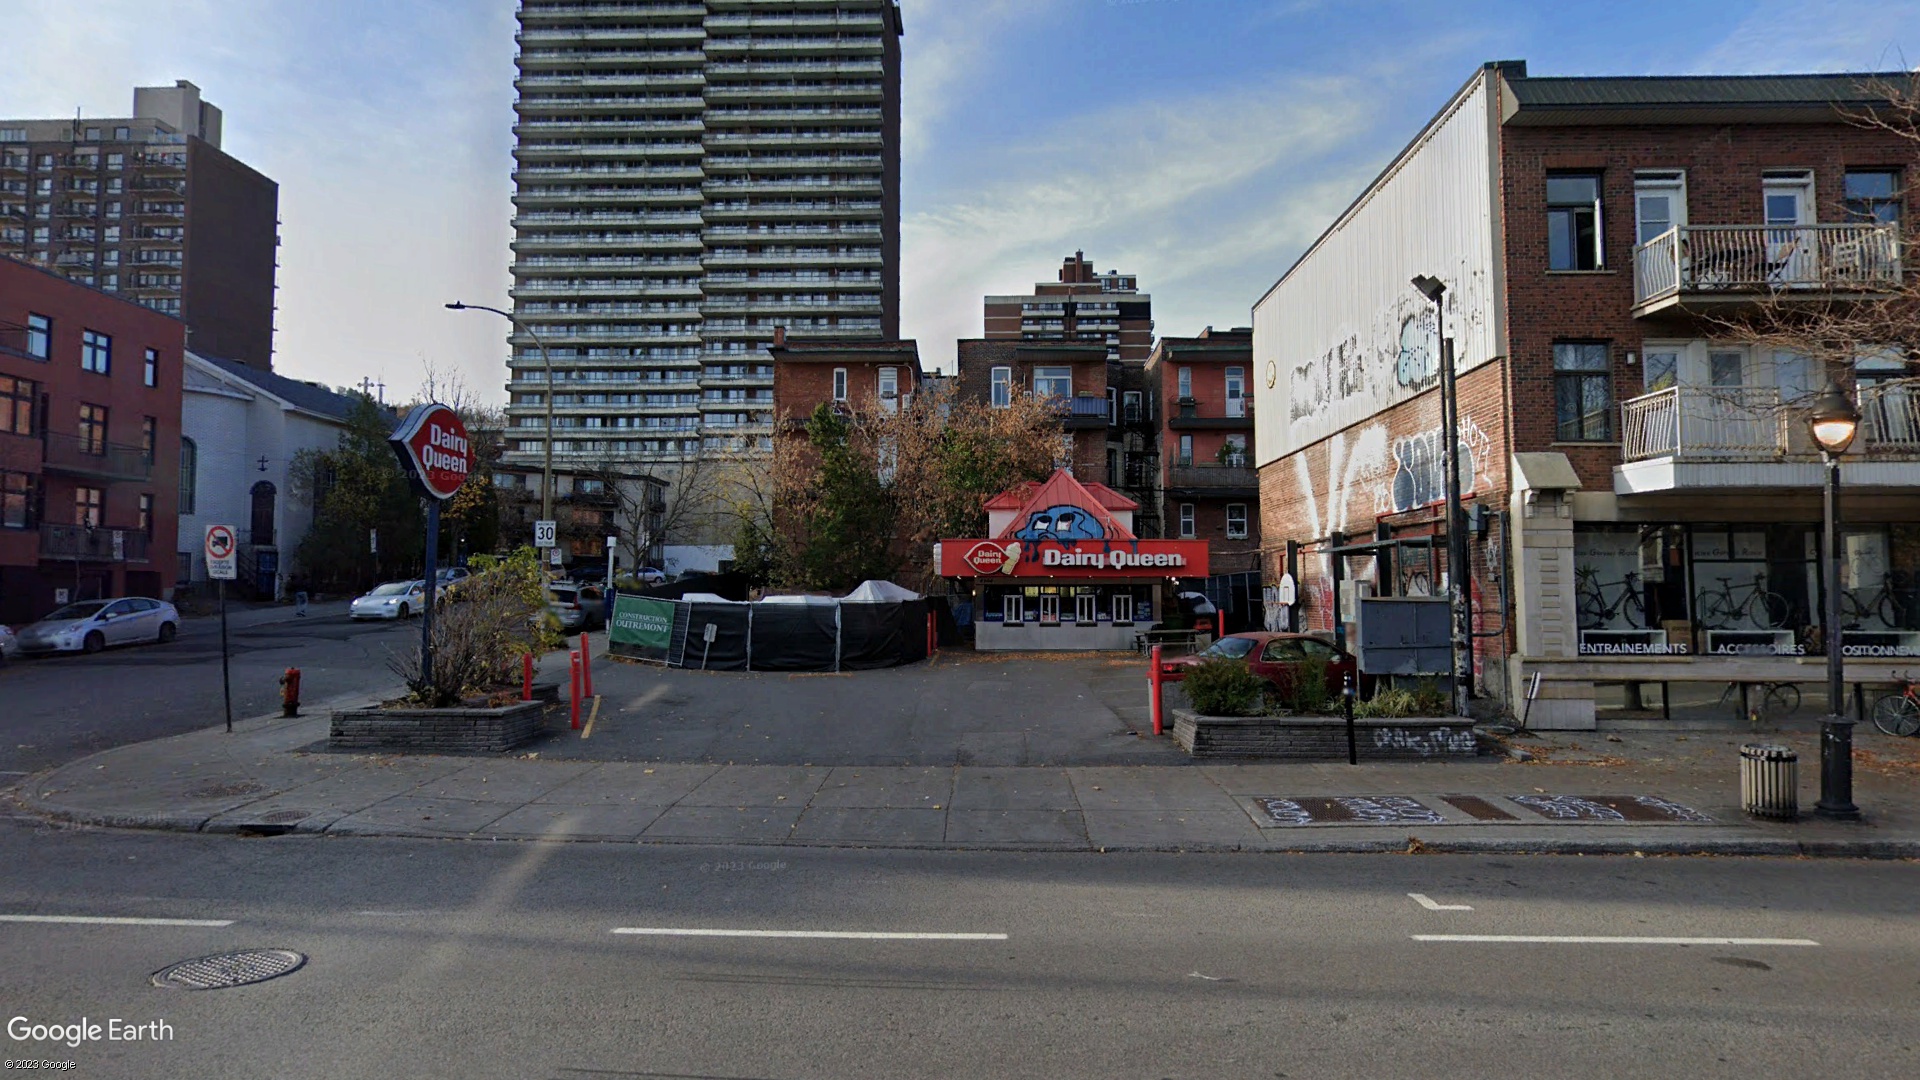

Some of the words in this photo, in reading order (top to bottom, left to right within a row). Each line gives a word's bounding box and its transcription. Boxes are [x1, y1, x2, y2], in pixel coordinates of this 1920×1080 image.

[430, 422, 468, 457] Dairy
[422, 445, 467, 473] Queen
[537, 526, 554, 540] 30
[973, 557, 1002, 565] Queen
[977, 550, 1002, 559] Dairy
[1043, 548, 1104, 569] Dairy
[1109, 549, 1182, 570] Queen
[618, 611, 668, 623] CONSTRUCTION
[616, 619, 669, 633] OUTREMONT
[1579, 643, 1687, 654] ENTRAINEMENTS
